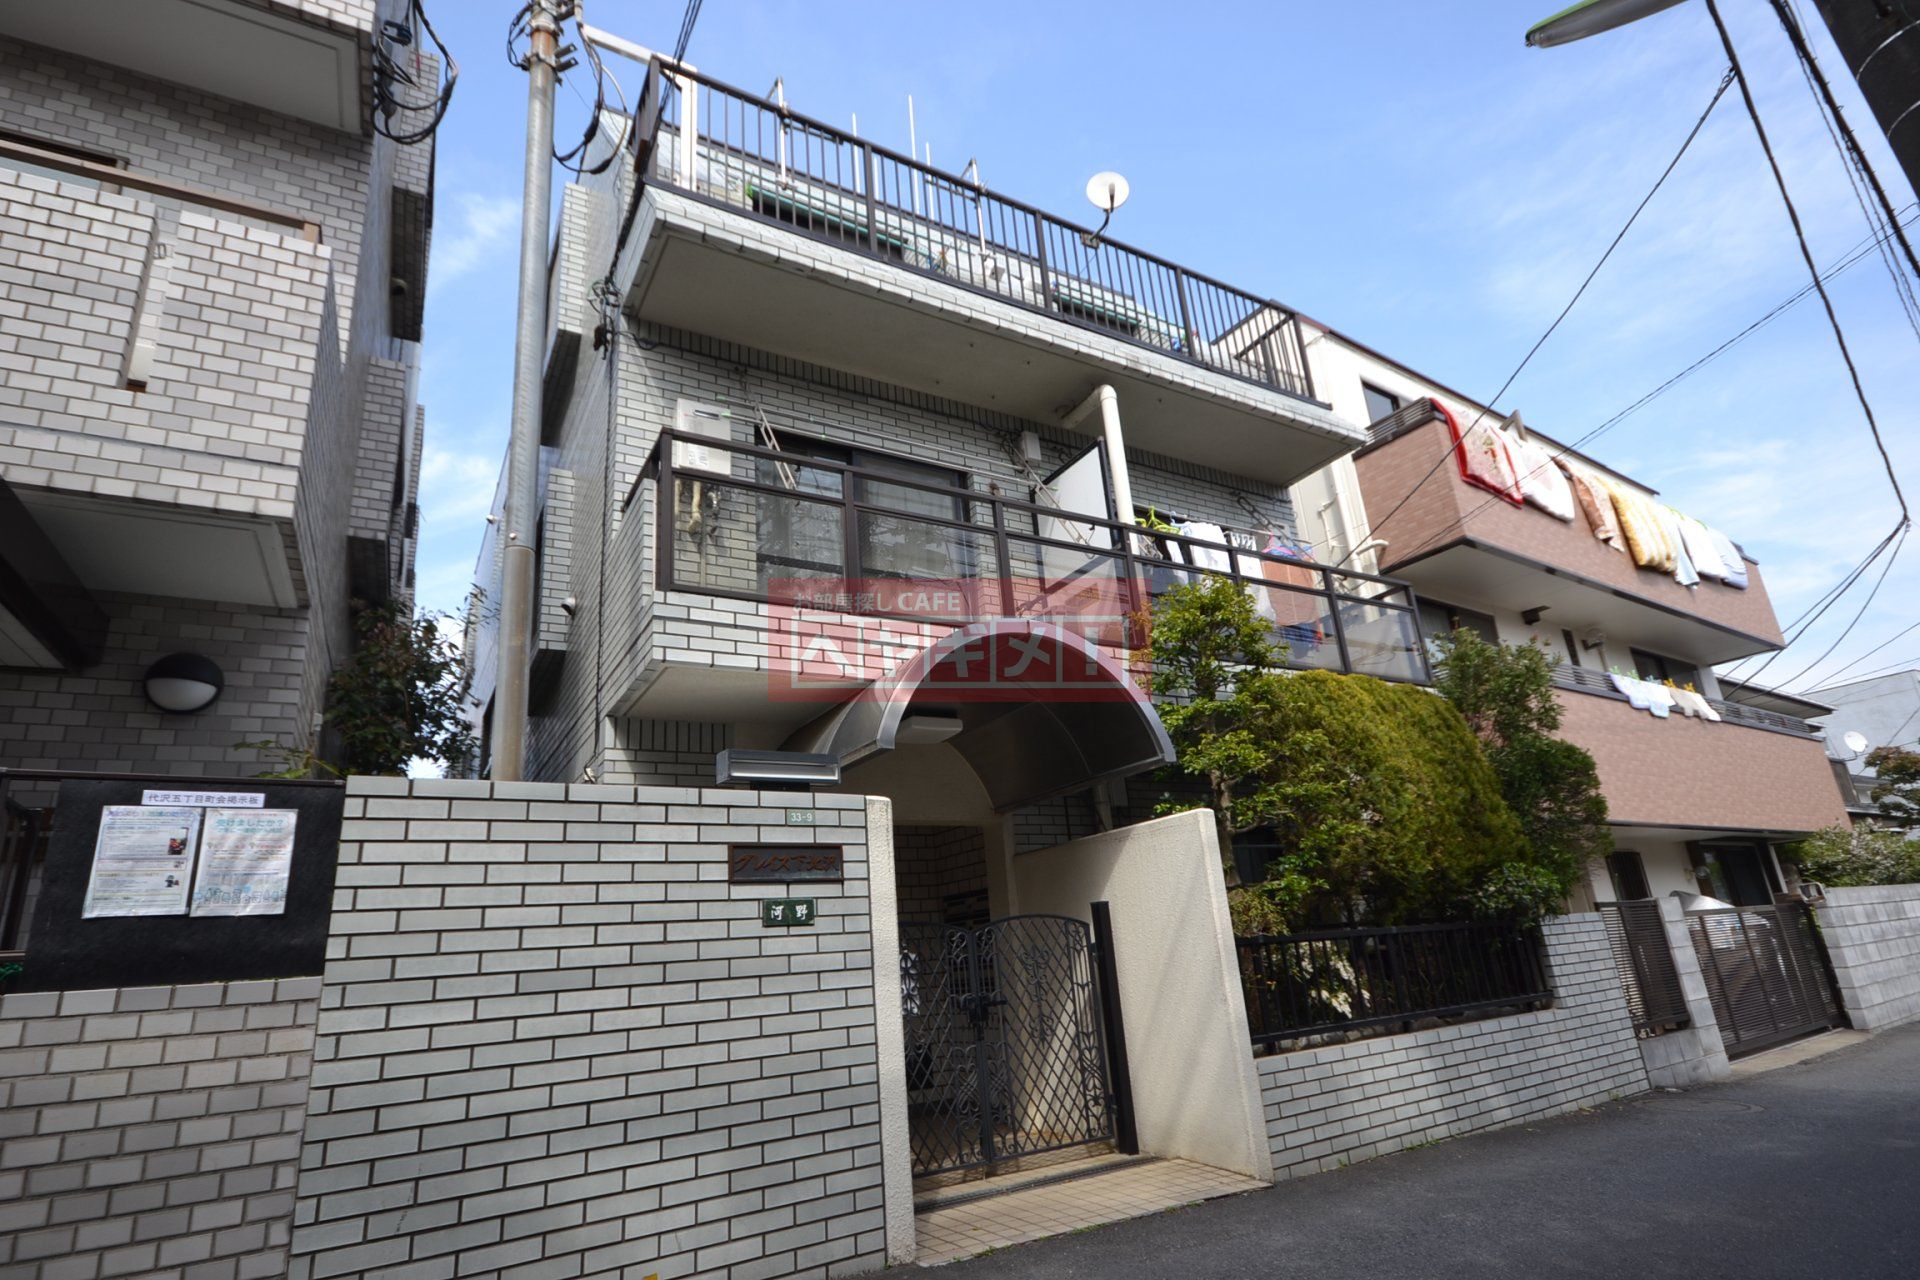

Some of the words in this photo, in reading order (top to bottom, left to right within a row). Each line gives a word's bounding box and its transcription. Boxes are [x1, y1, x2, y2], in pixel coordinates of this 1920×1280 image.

[148, 793, 259, 805] 代沢五丁目町会掲示板
[790, 812, 813, 822] 33-9
[770, 904, 809, 921] 河野
